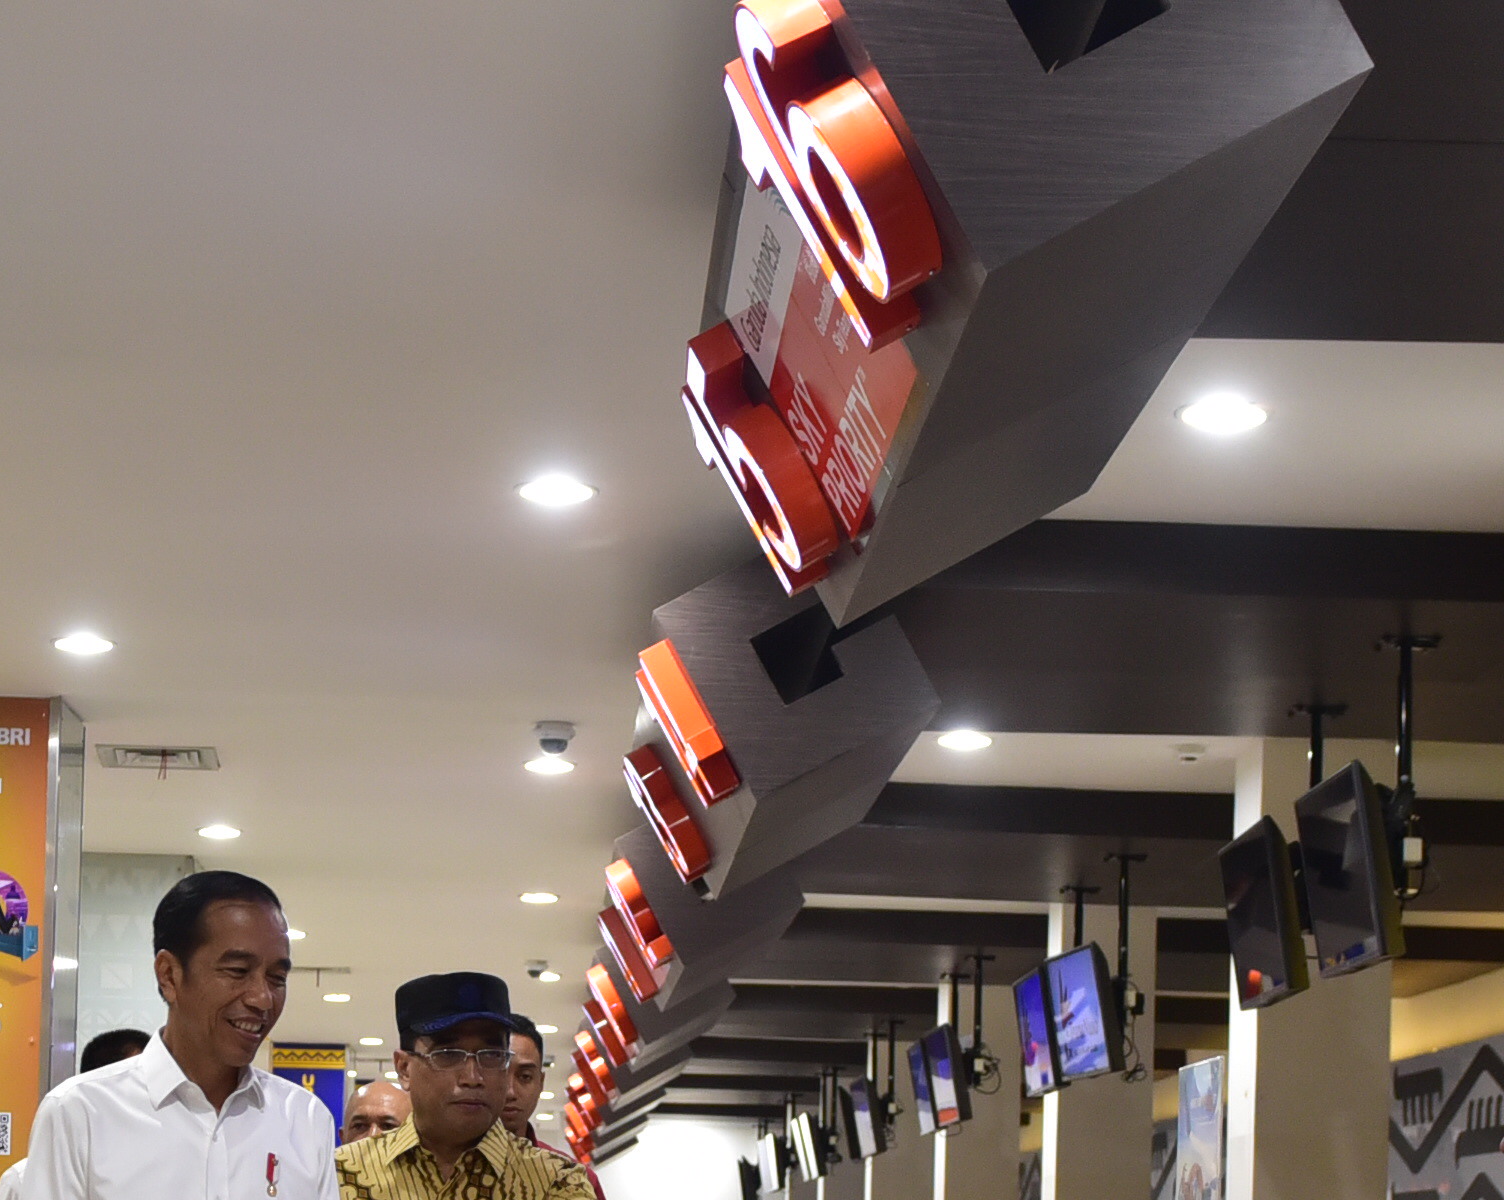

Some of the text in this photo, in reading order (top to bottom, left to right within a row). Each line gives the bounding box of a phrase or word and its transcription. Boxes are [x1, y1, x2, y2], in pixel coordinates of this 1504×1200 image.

[723, 0, 936, 352] 16
[788, 372, 827, 464] SKY
[822, 380, 887, 531] PRIORITY
